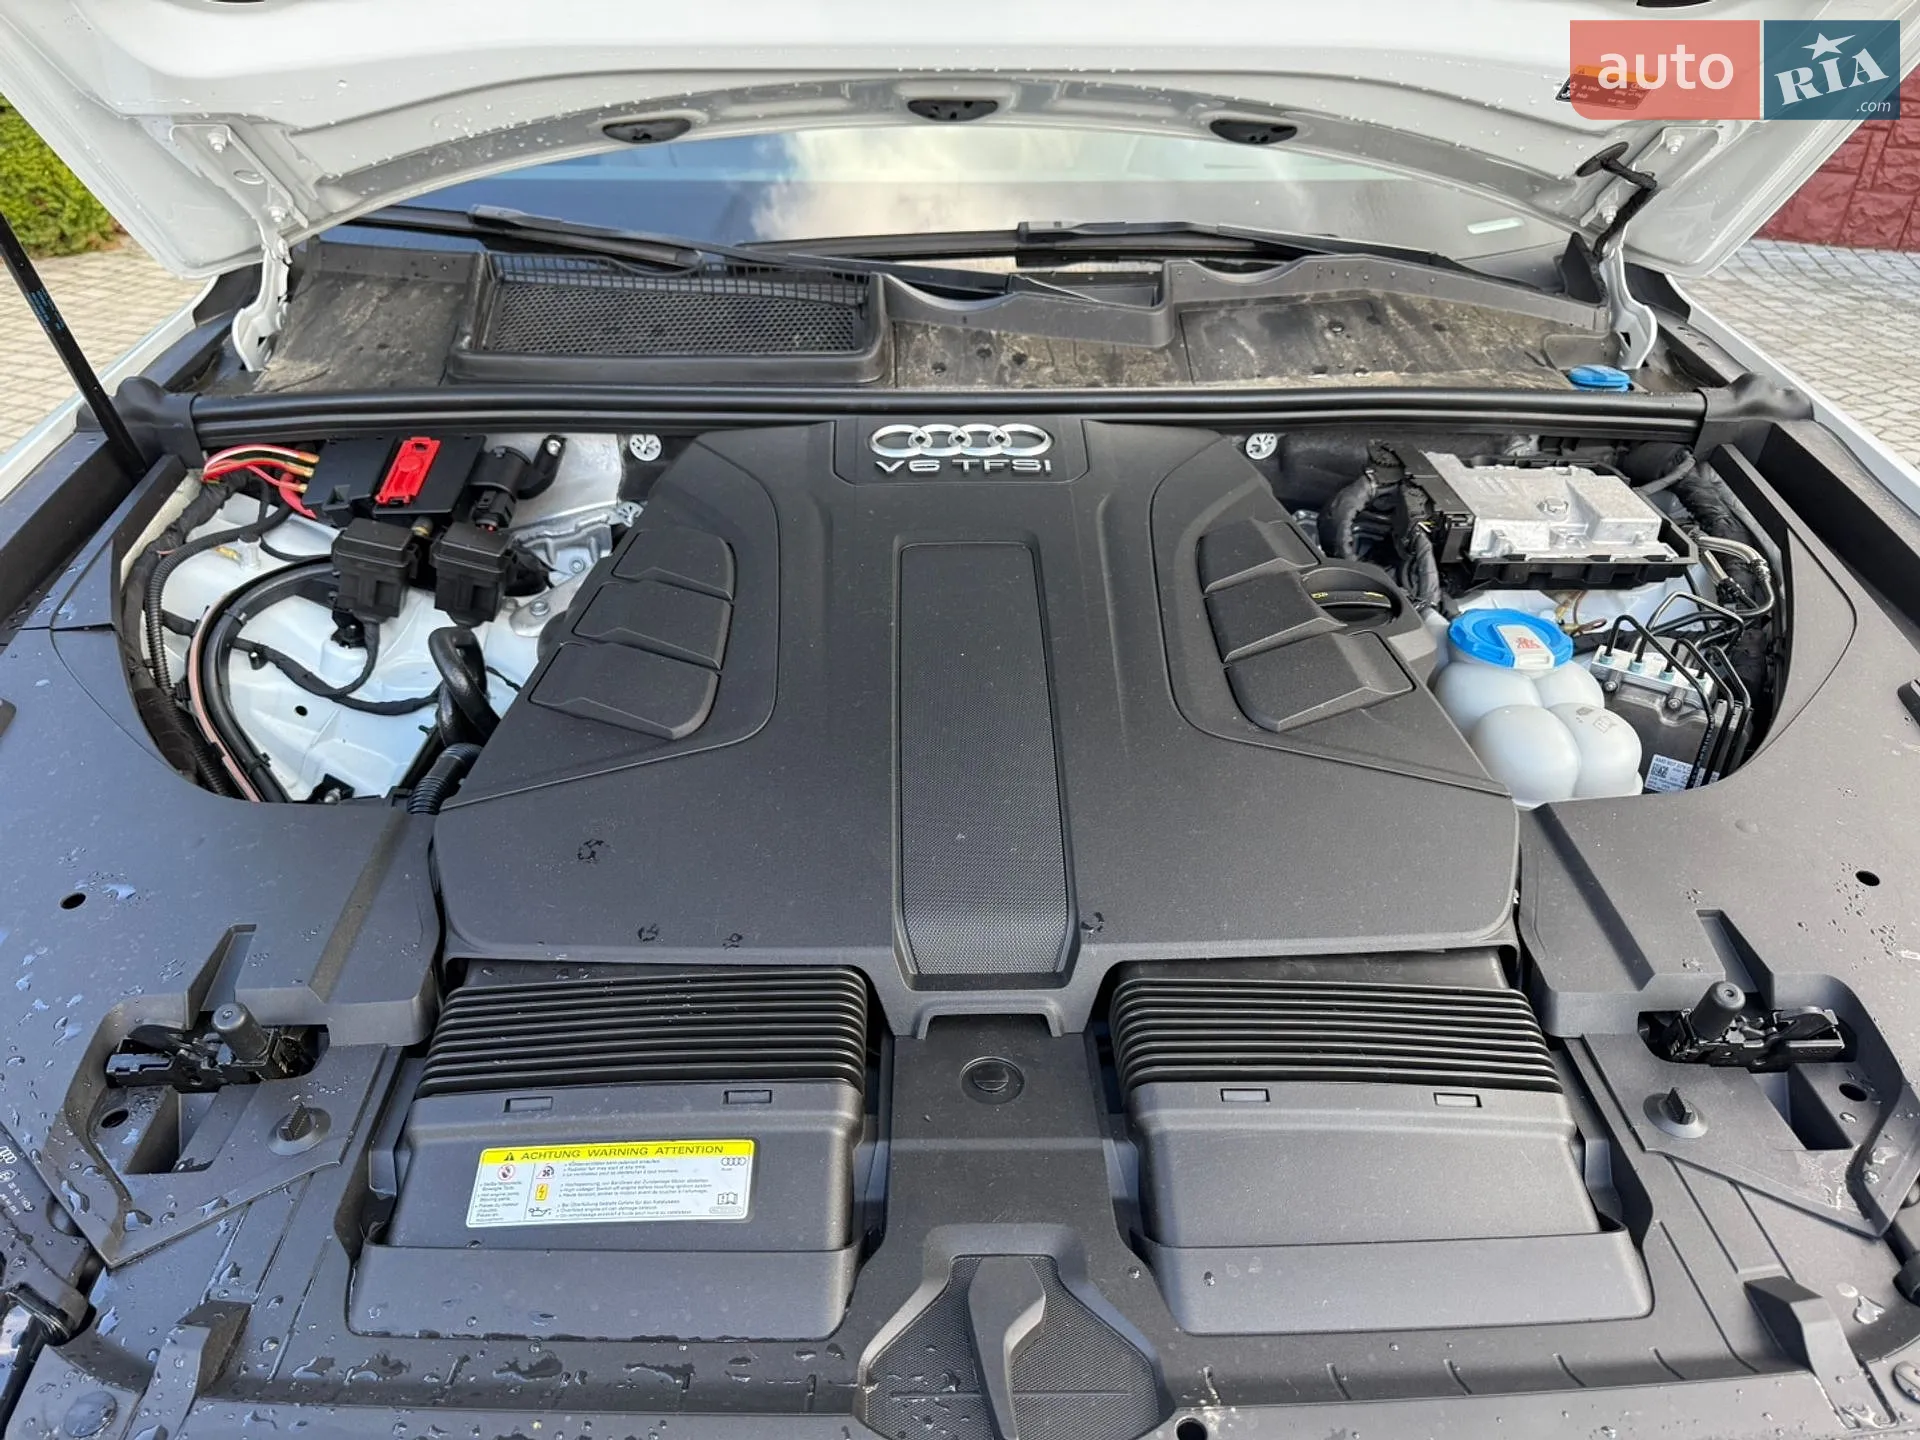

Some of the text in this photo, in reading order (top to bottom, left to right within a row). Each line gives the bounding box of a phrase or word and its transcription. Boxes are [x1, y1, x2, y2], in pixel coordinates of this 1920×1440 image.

[875, 459, 1052, 473] V6 TFSI
[520, 1145, 724, 1160] ACHTUNG WARNING ATTENTION
